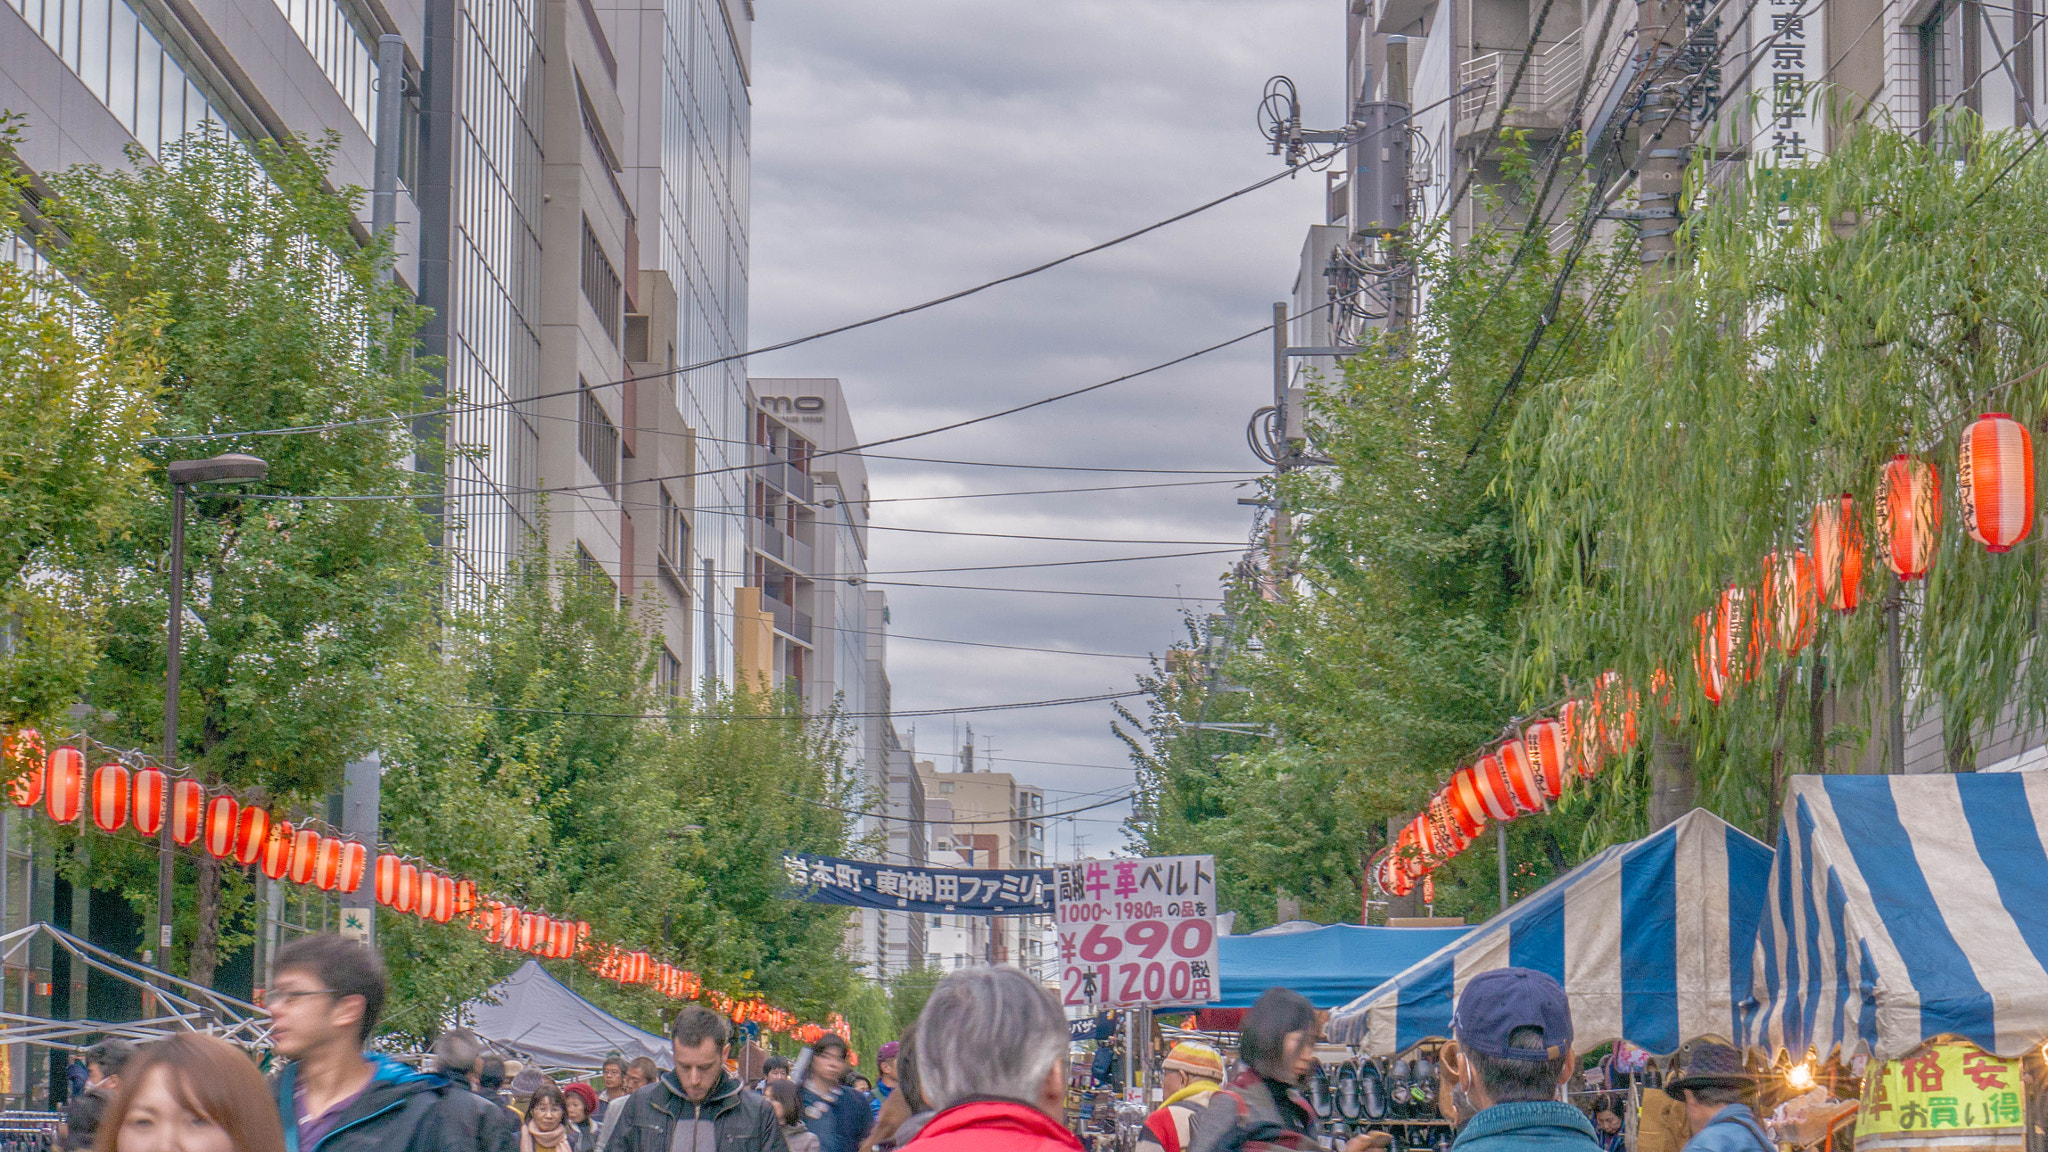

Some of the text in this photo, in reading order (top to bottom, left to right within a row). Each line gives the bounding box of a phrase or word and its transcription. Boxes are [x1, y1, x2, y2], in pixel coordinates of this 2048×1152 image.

[1770, 0, 1806, 159] 東京甲子社
[760, 396, 824, 411] mo
[1058, 860, 1212, 901] 高級牛革ベルト
[1060, 918, 1213, 964] ¥690
[1900, 1092, 2021, 1129] お買い得
